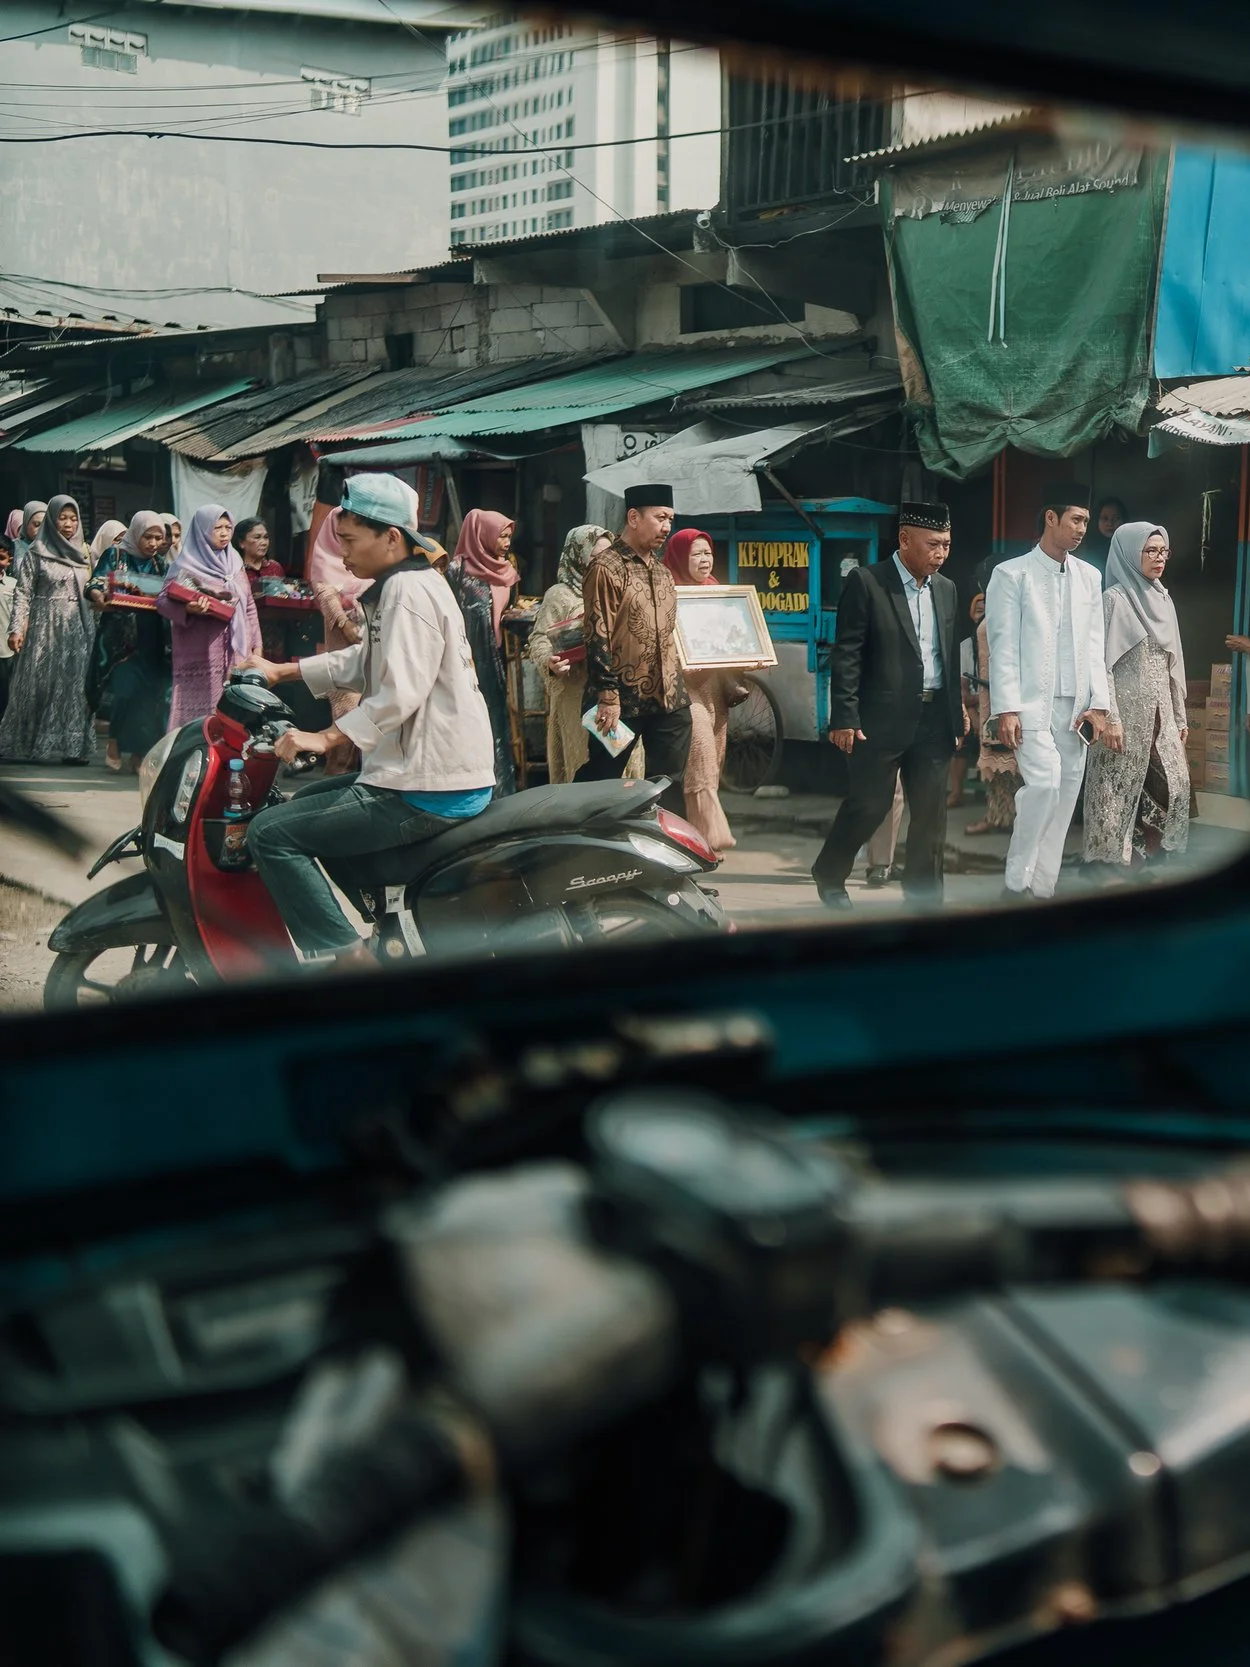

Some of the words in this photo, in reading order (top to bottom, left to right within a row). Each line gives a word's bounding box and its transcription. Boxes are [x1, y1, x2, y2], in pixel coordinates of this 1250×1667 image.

[1023, 187, 1045, 201] Jual
[1066, 181, 1091, 196] Alat
[738, 542, 809, 568] KETOPRAK
[768, 571, 780, 589] &
[565, 869, 643, 891] Scoopy
